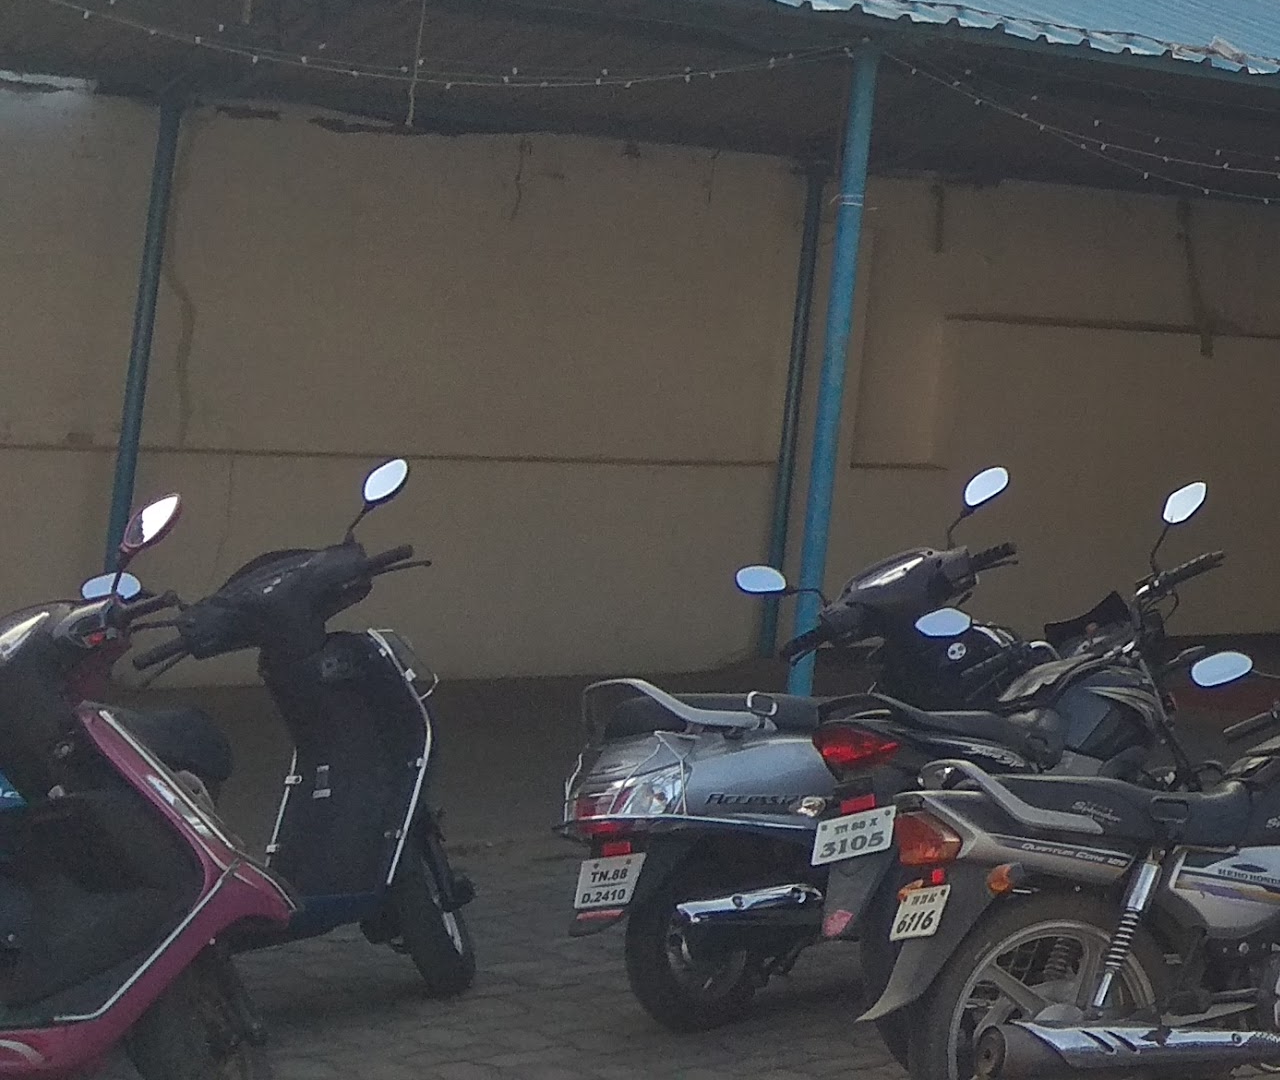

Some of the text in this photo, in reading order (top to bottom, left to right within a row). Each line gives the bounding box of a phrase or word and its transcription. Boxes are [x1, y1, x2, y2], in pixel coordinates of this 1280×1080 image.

[820, 831, 884, 858] 3105
[591, 868, 628, 883] TN.88
[581, 889, 626, 904] D.2410
[896, 910, 935, 934] 6116
